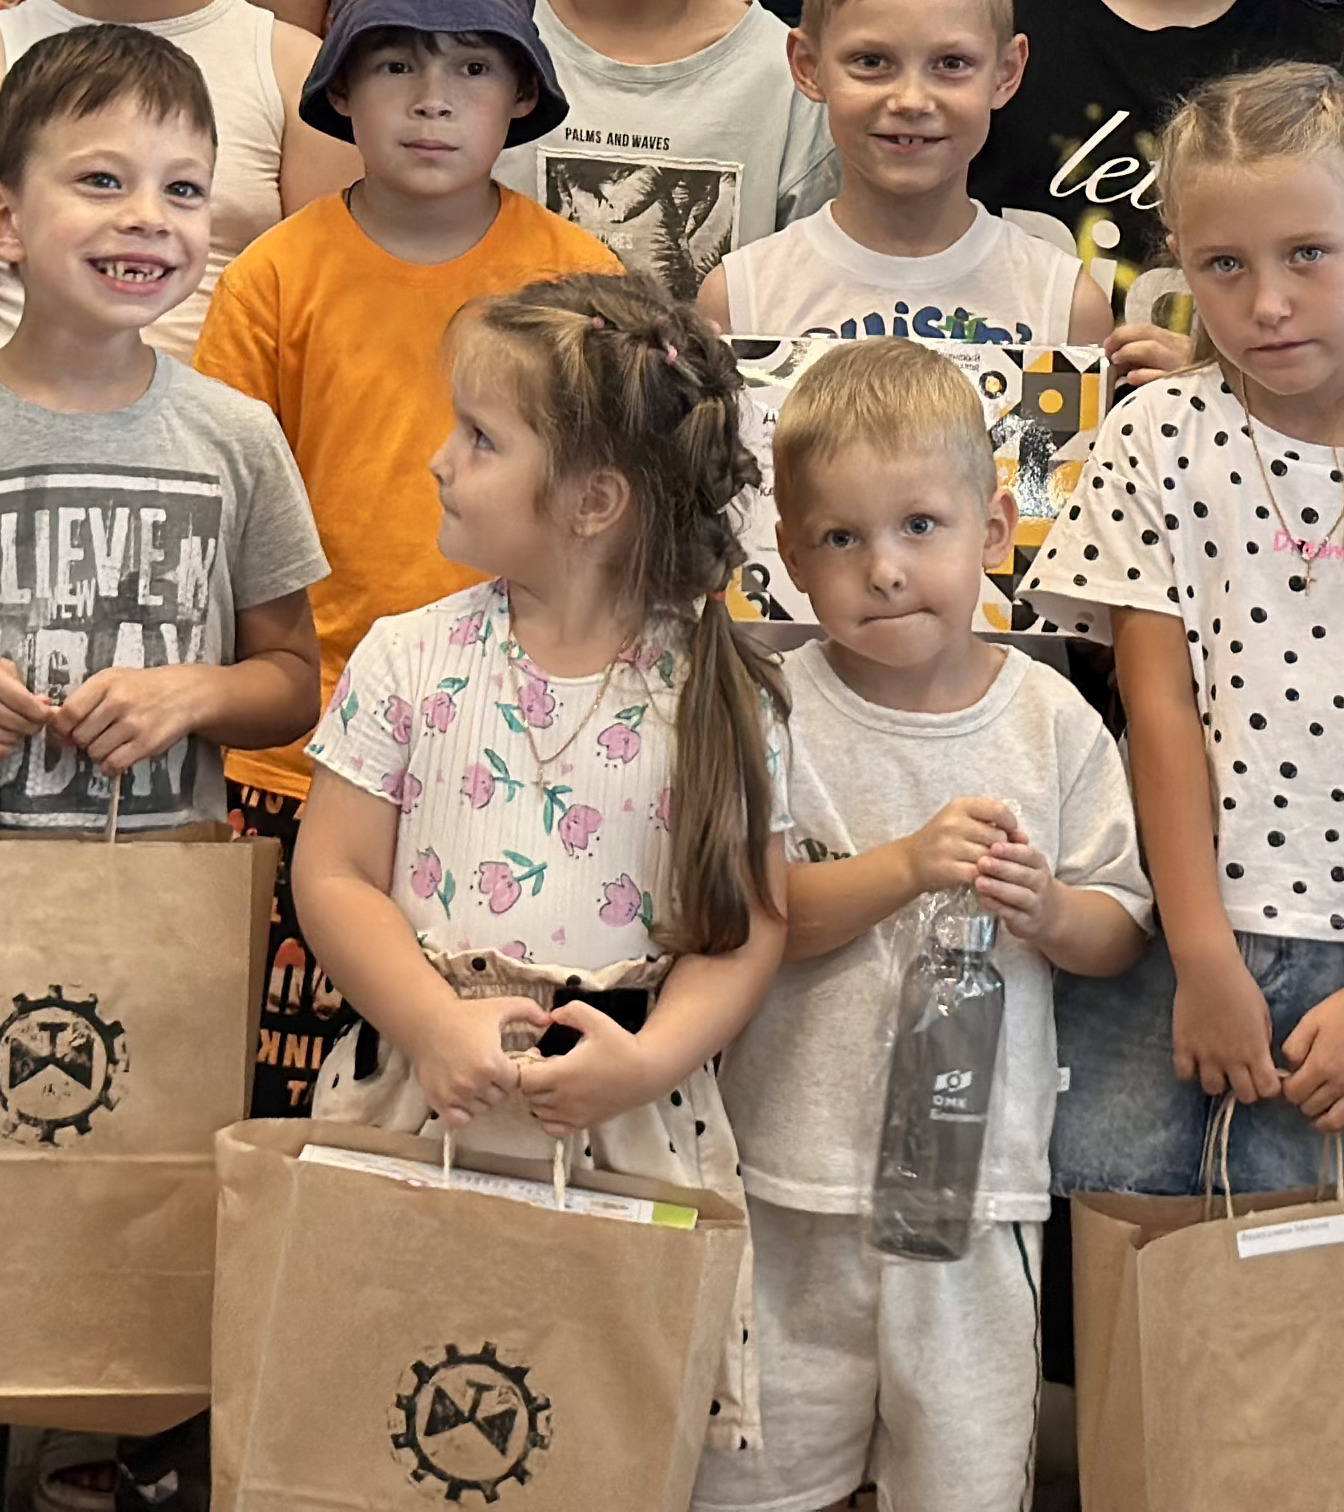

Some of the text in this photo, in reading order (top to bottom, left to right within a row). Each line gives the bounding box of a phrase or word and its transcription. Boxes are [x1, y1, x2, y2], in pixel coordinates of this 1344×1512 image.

[564, 126, 671, 151] PALMS AND WAVES
